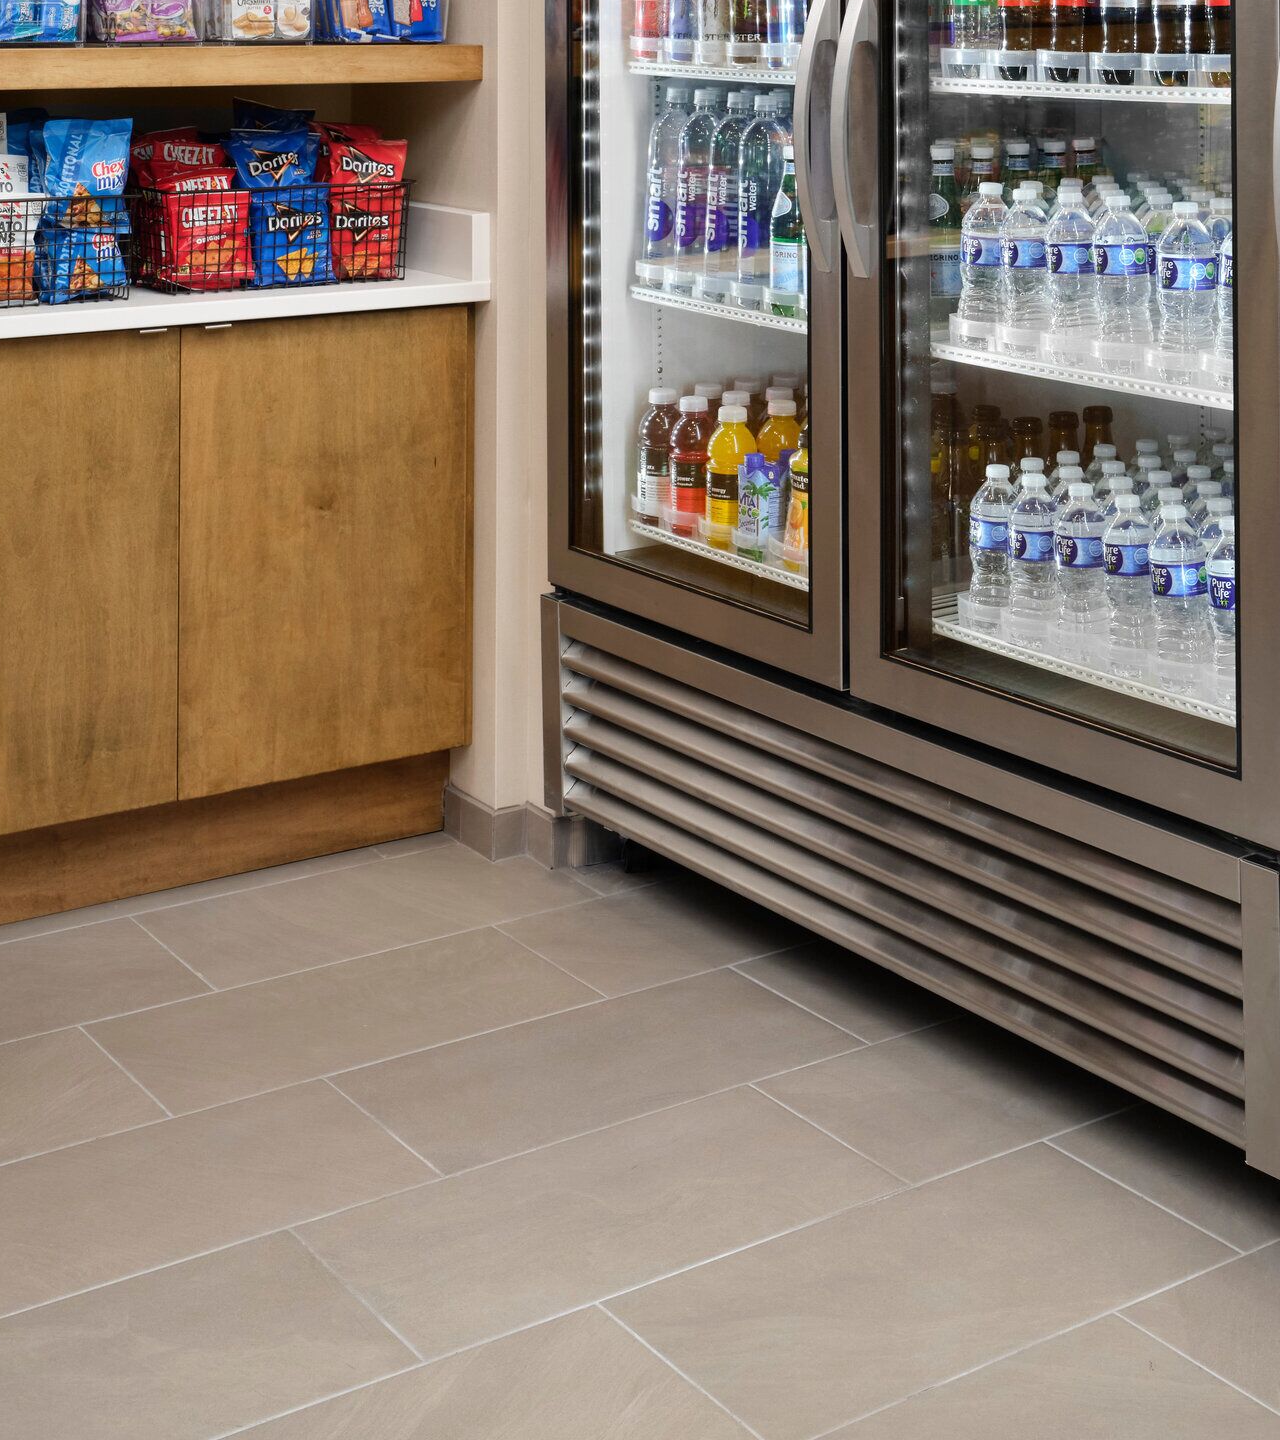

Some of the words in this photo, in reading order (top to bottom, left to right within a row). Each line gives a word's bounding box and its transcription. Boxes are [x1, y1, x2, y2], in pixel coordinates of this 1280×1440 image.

[91, 158, 126, 177] Chex
[249, 151, 299, 176] Doritos
[342, 156, 395, 177] Doritos
[96, 174, 125, 190] mix
[647, 167, 663, 232] smart
[676, 170, 688, 238] smart
[748, 180, 757, 212] water
[705, 172, 719, 242] smart
[268, 212, 323, 232] Doritos
[335, 215, 389, 228] Doritos
[1151, 565, 1168, 575] Pure
[1152, 574, 1166, 586] Life
[1212, 578, 1232, 591] Pure
[1214, 587, 1230, 601] Life
